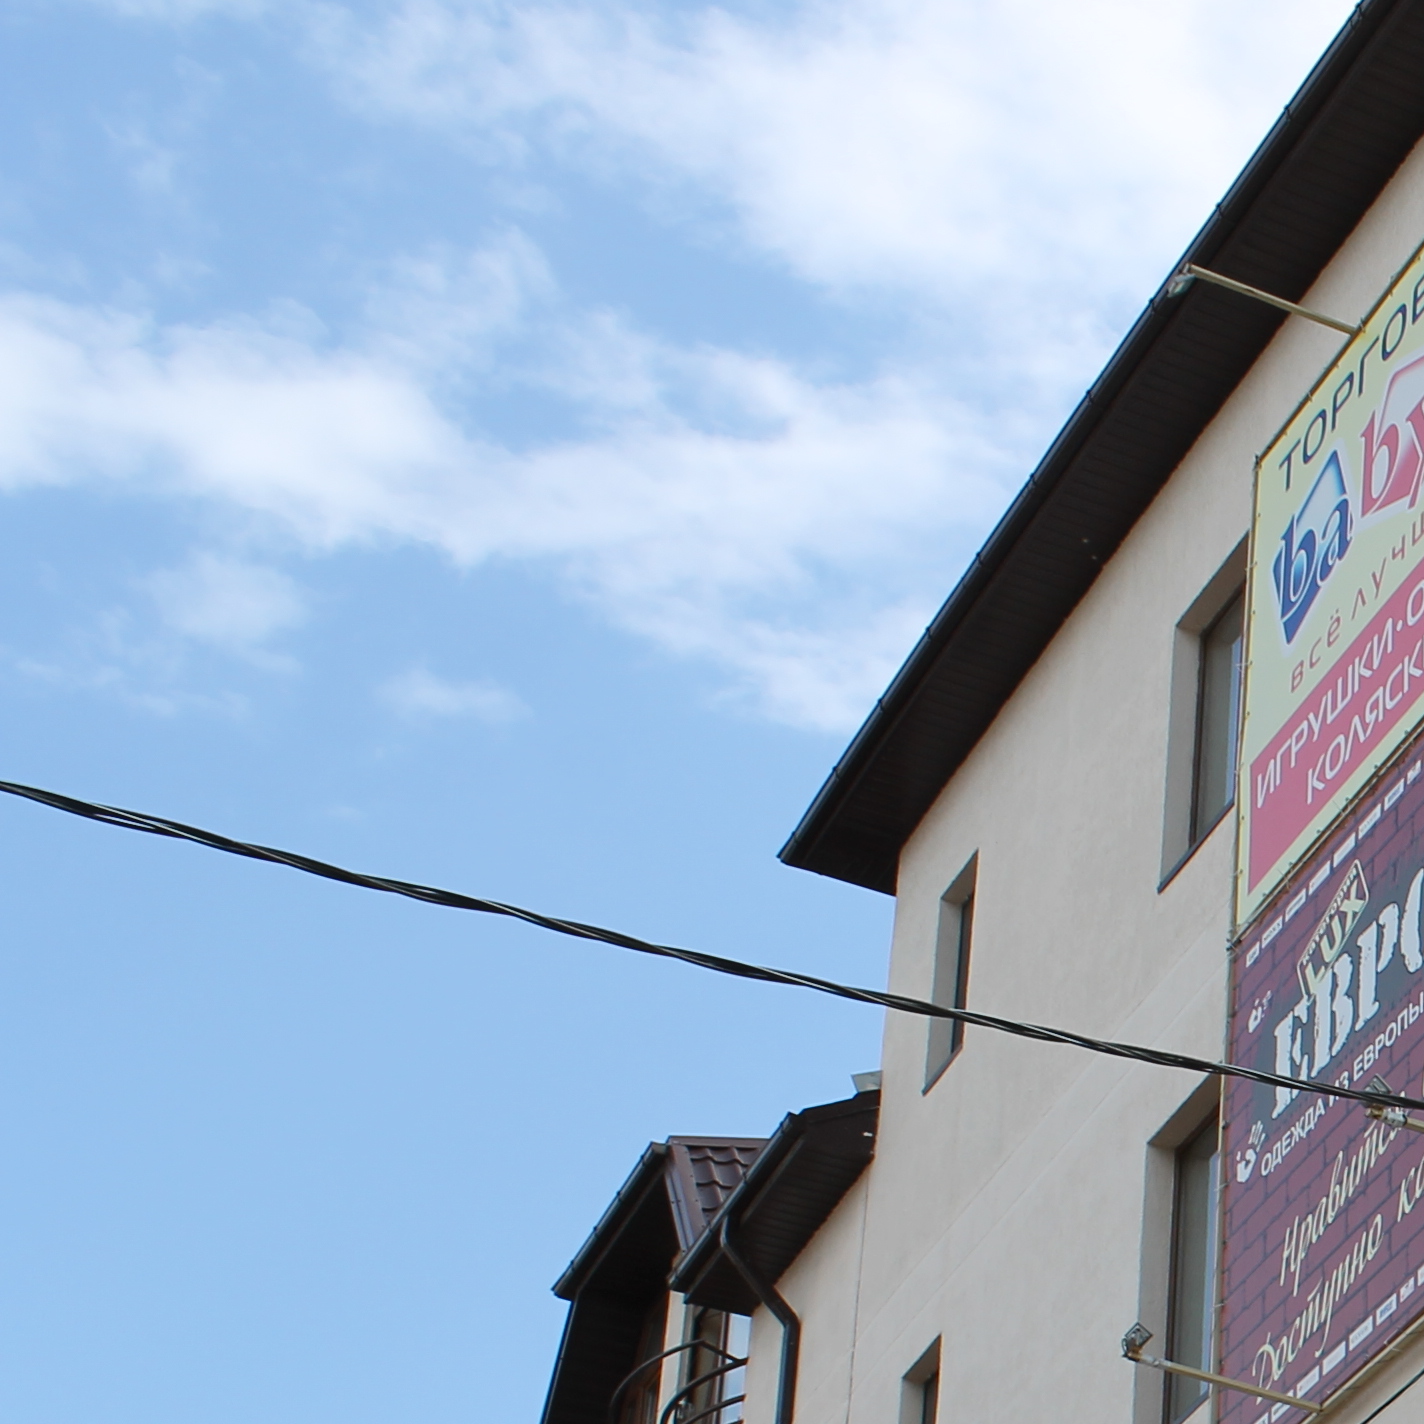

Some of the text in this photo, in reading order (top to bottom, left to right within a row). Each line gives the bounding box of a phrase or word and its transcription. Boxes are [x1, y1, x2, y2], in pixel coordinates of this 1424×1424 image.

[1256, 616, 1394, 809] ИГРУШКИ
[1290, 607, 1342, 693] всё
[1304, 876, 1366, 995] LUX
[1260, 1097, 1326, 1177] ОДЕЖДА
[1352, 990, 1424, 1083] ЕВРОПЫ
[1251, 1213, 1384, 1406] Доступно
